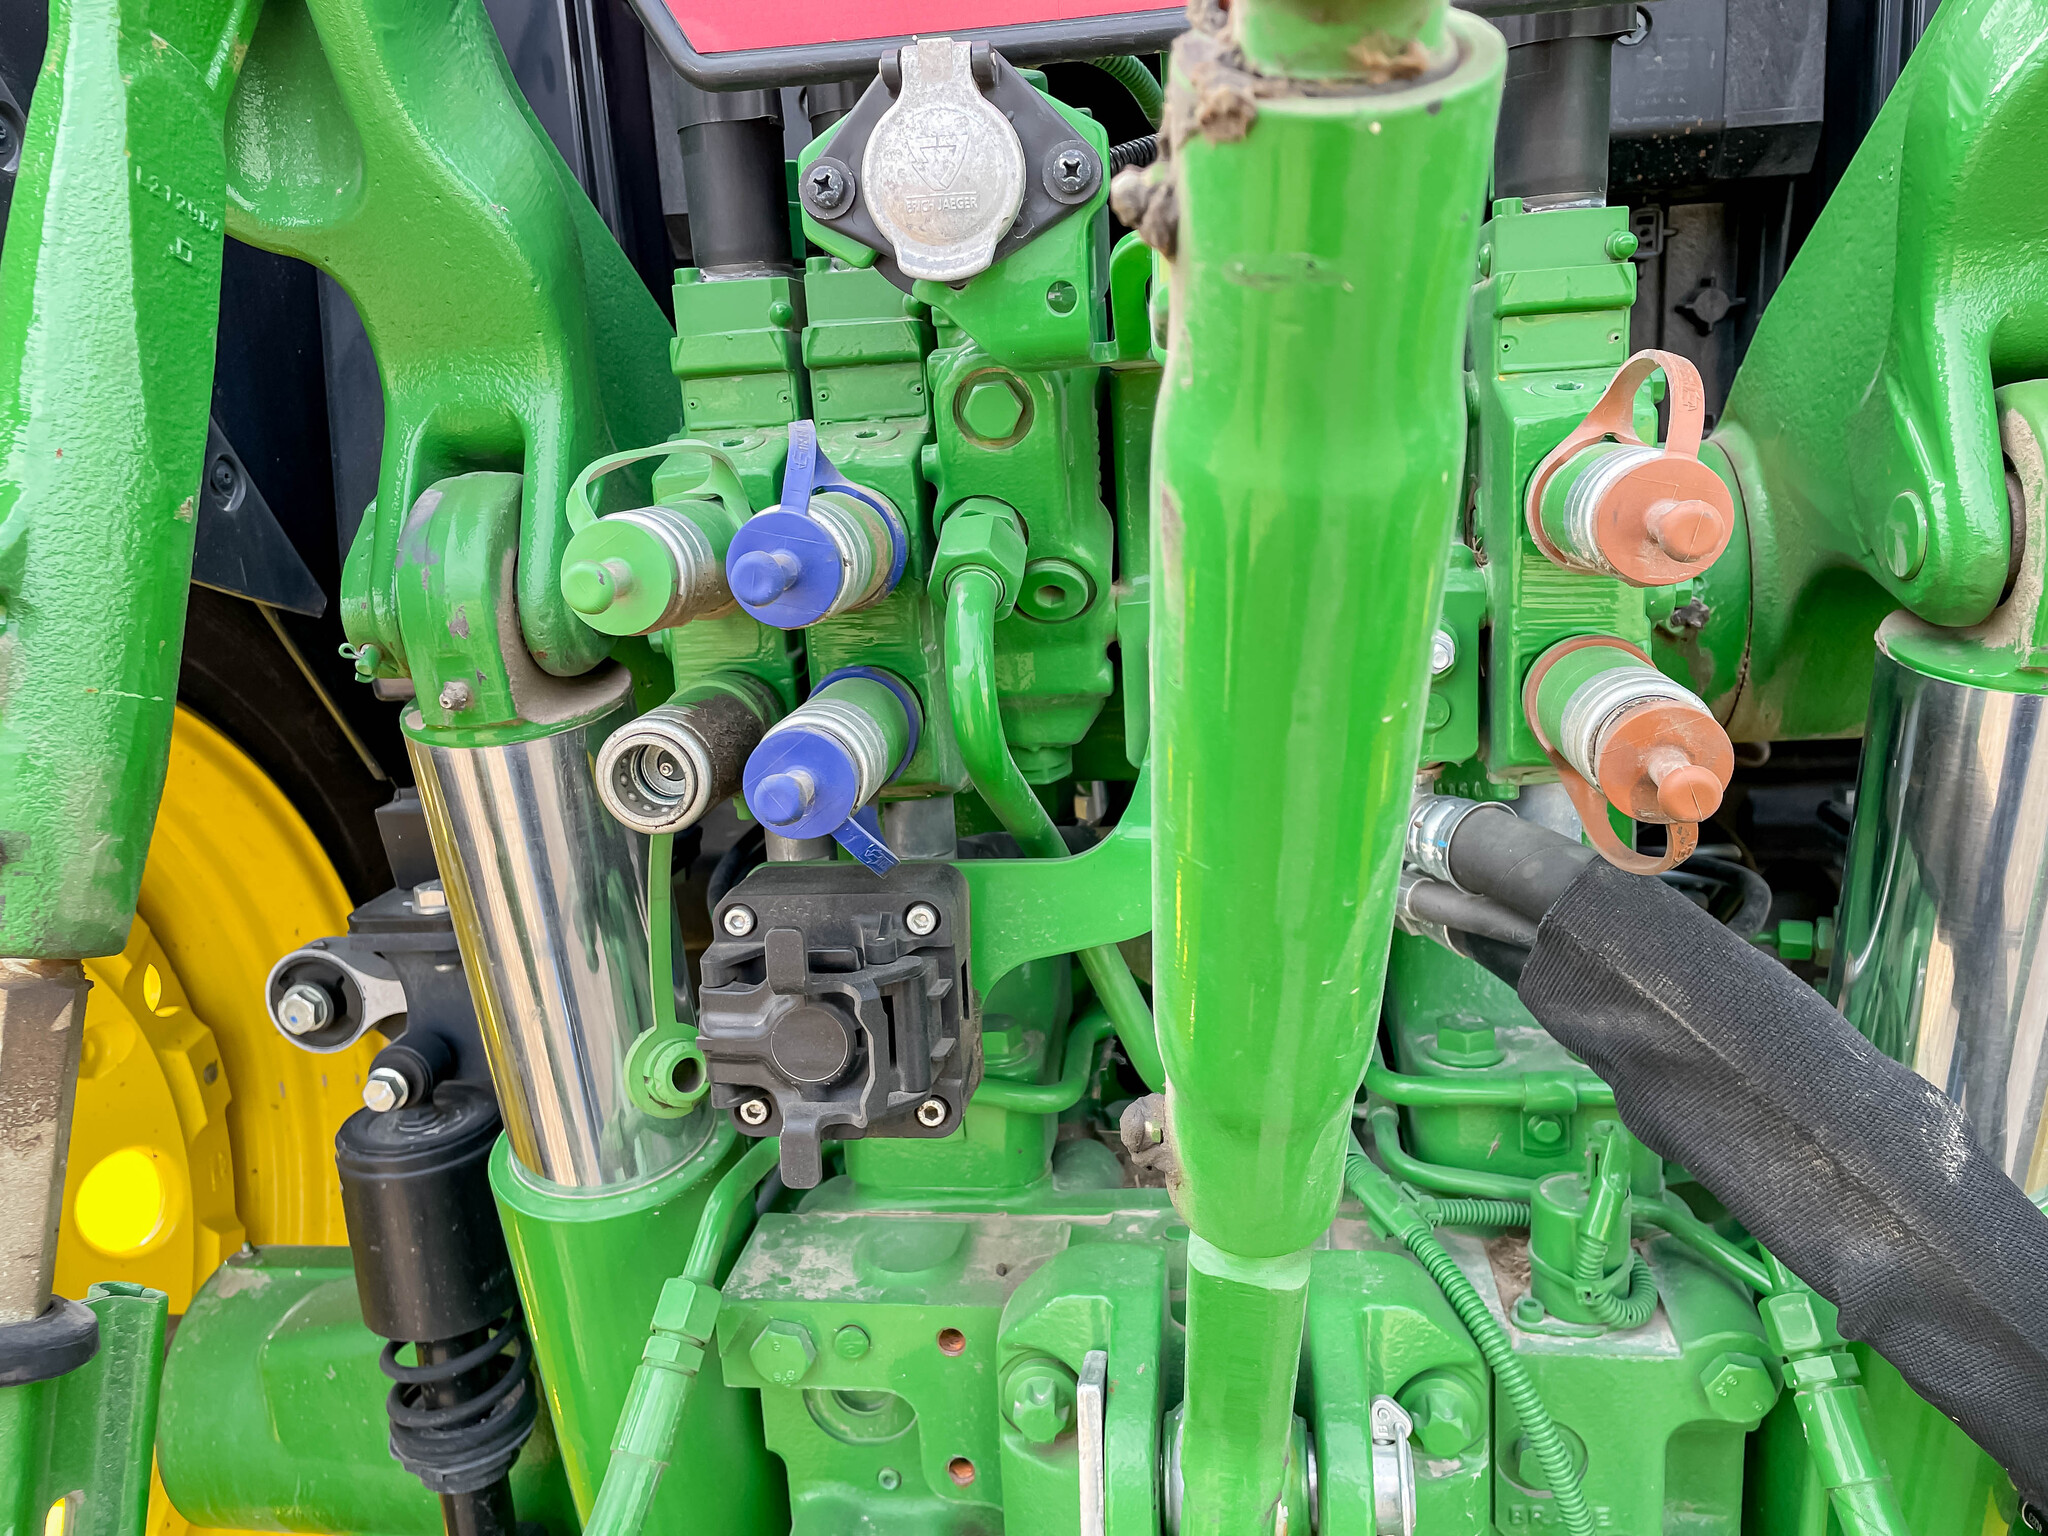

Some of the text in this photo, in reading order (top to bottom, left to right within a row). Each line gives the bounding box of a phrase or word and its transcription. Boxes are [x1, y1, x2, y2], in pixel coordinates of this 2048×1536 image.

[906, 196, 978, 214] ERICH JAEGER
[1508, 1503, 1613, 1526] BRE
